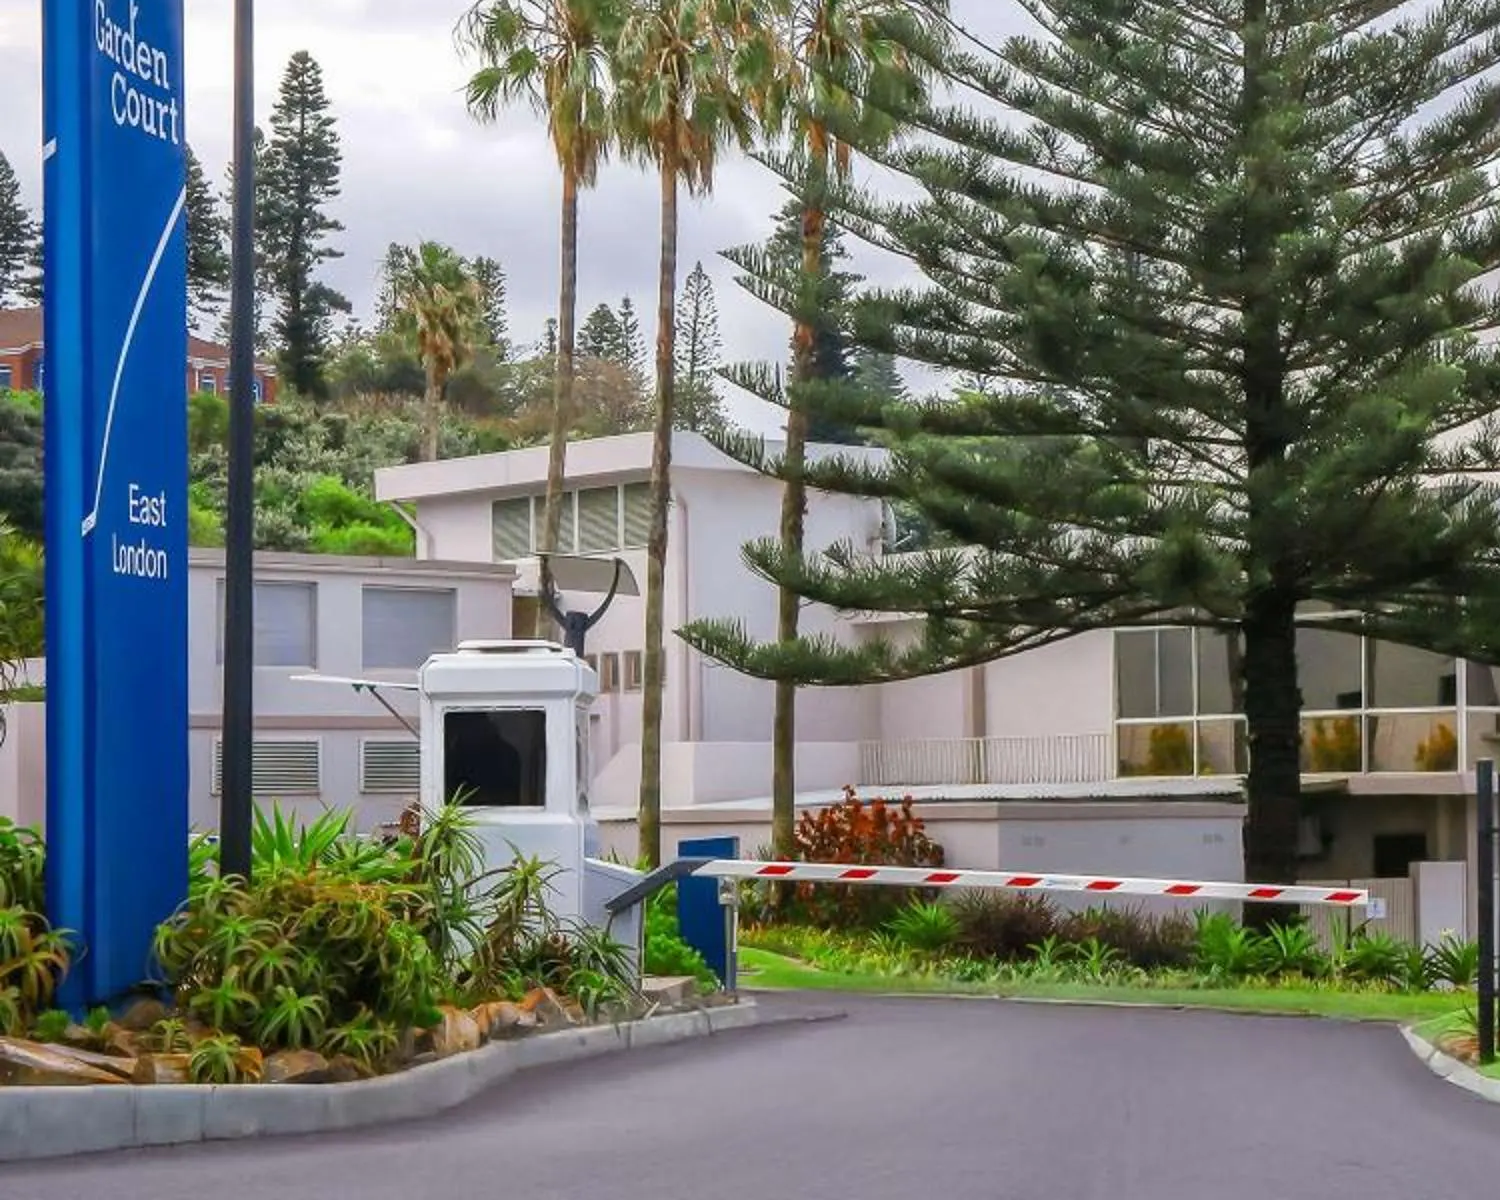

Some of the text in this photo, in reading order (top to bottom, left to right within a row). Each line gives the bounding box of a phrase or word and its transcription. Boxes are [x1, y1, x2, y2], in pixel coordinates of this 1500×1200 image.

[111, 71, 179, 145] Court
[128, 482, 167, 527] East
[112, 531, 167, 580] London
